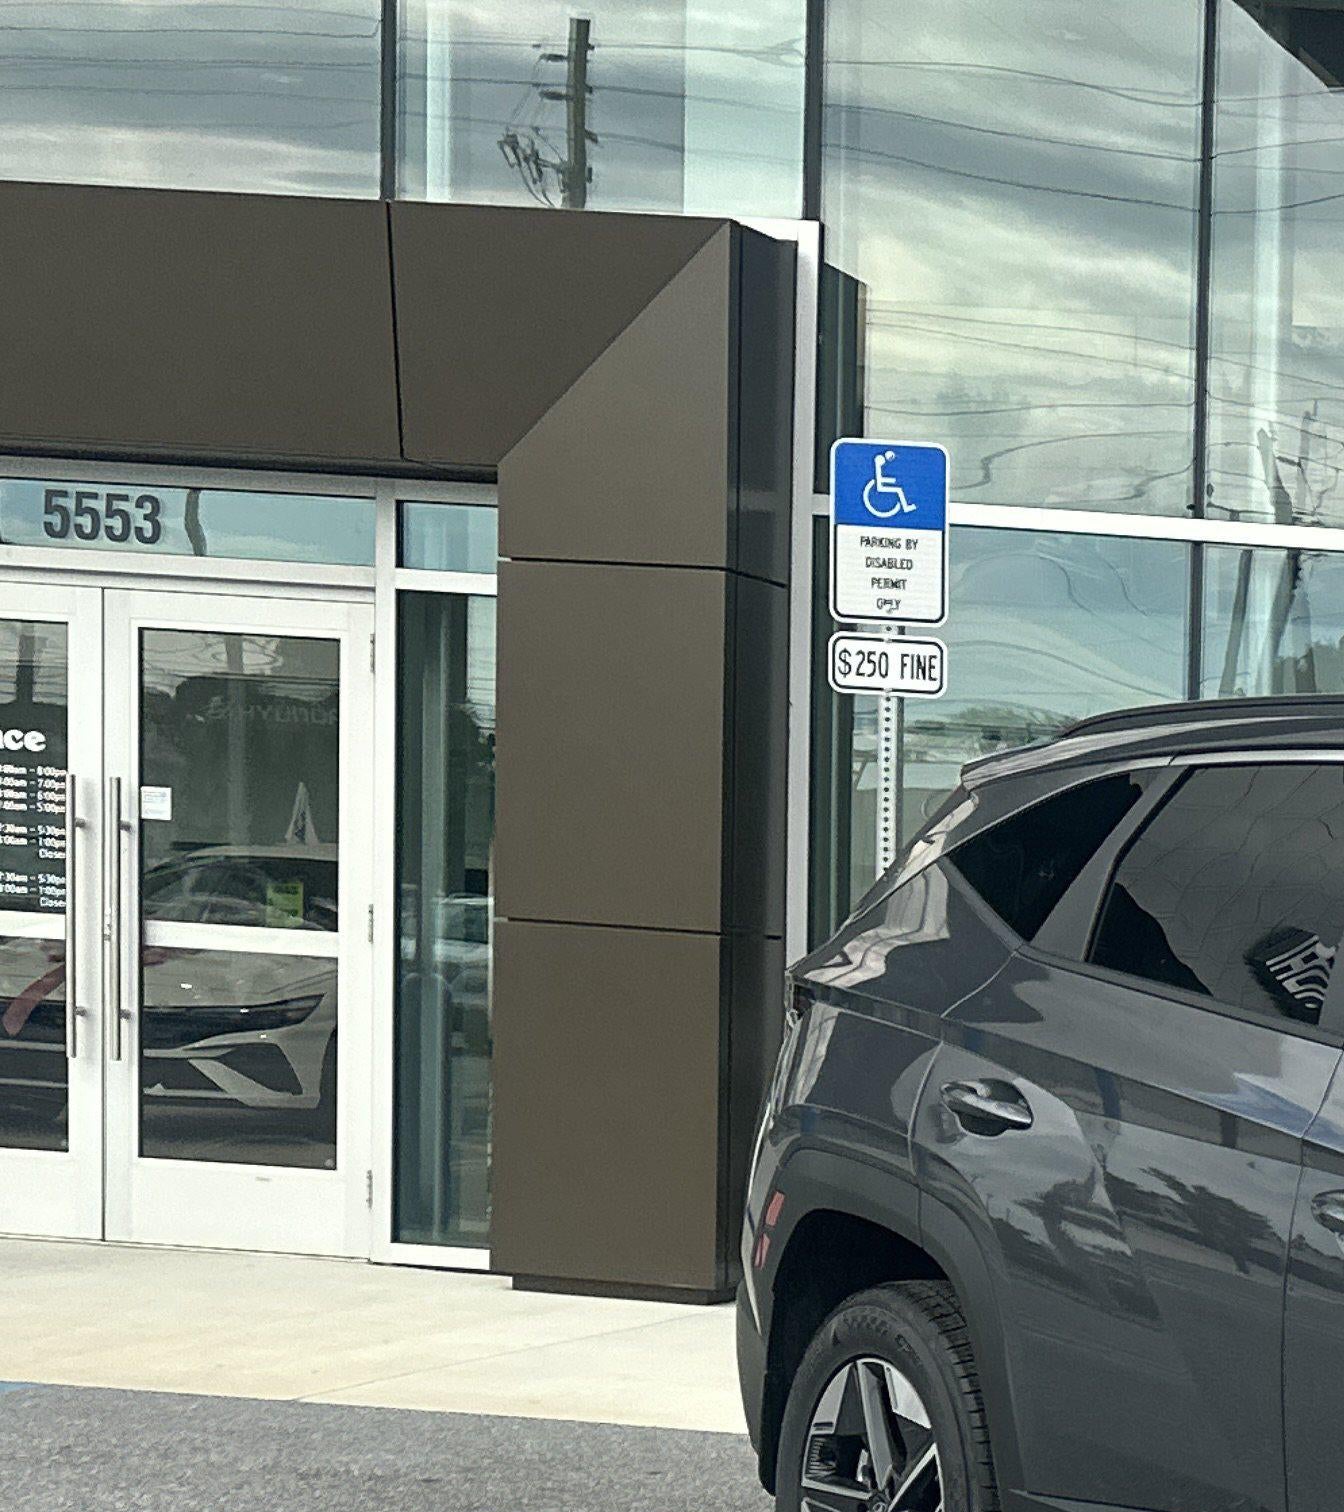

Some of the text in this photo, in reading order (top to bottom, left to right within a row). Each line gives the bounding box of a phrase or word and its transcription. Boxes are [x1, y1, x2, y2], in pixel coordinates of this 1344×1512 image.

[43, 488, 162, 545] 5553
[860, 535, 918, 550] PARKING BY
[865, 556, 914, 570] DISABLED
[871, 577, 907, 590] PERMIT
[838, 648, 937, 682] $250 FINE
[0, 729, 47, 752] ce
